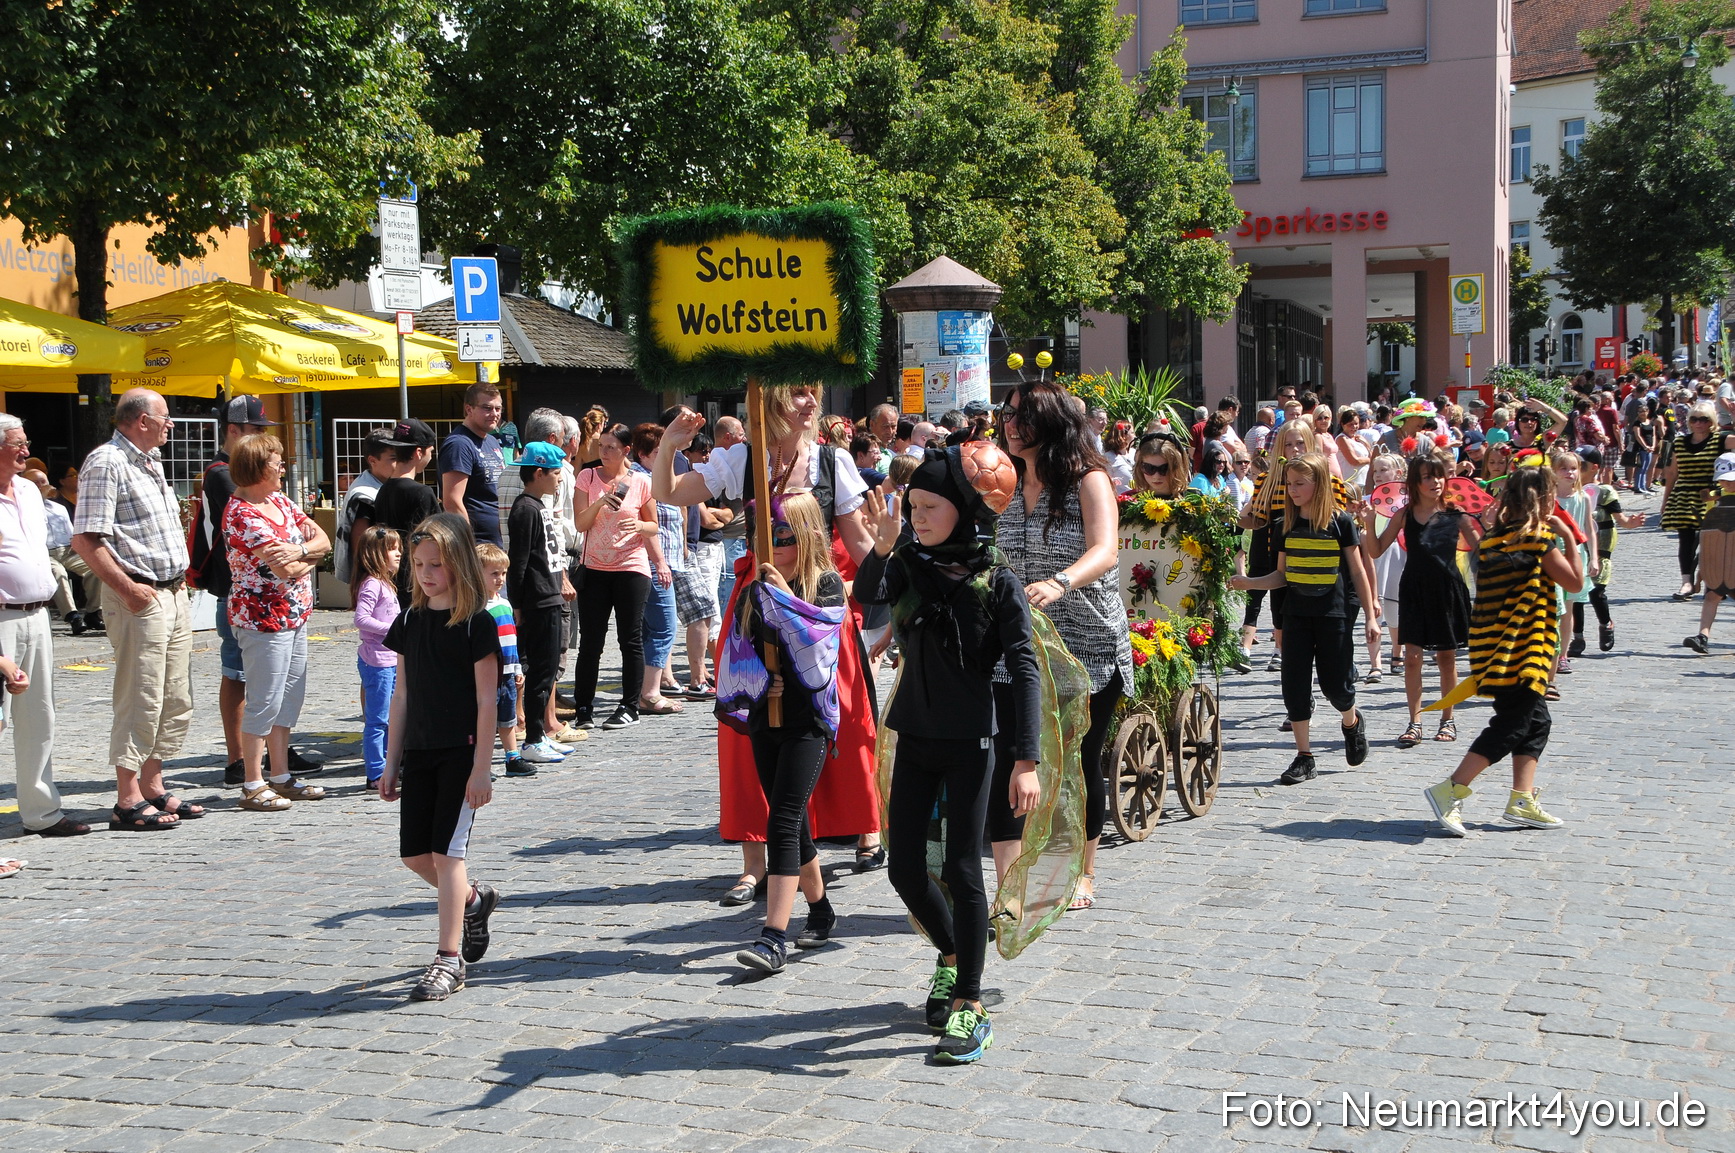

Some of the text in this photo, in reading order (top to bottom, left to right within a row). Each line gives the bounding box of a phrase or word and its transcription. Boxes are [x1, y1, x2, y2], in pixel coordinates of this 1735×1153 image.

[388, 209, 410, 218] nur mit
[384, 218, 416, 230] Parkschein
[1236, 207, 1389, 242] Sparkasse
[387, 231, 414, 243] werktags
[384, 243, 400, 253] Mo-Fr
[0, 237, 74, 283] Metzge
[112, 252, 166, 287] Heiße
[384, 255, 392, 264] Sa
[696, 246, 801, 282] Schule
[462, 266, 488, 314] P
[1460, 284, 1473, 299] H
[677, 298, 828, 335] Wolfstein
[297, 353, 336, 366] Bäckerei
[346, 354, 366, 367] Café
[378, 355, 423, 368] Kondorei
